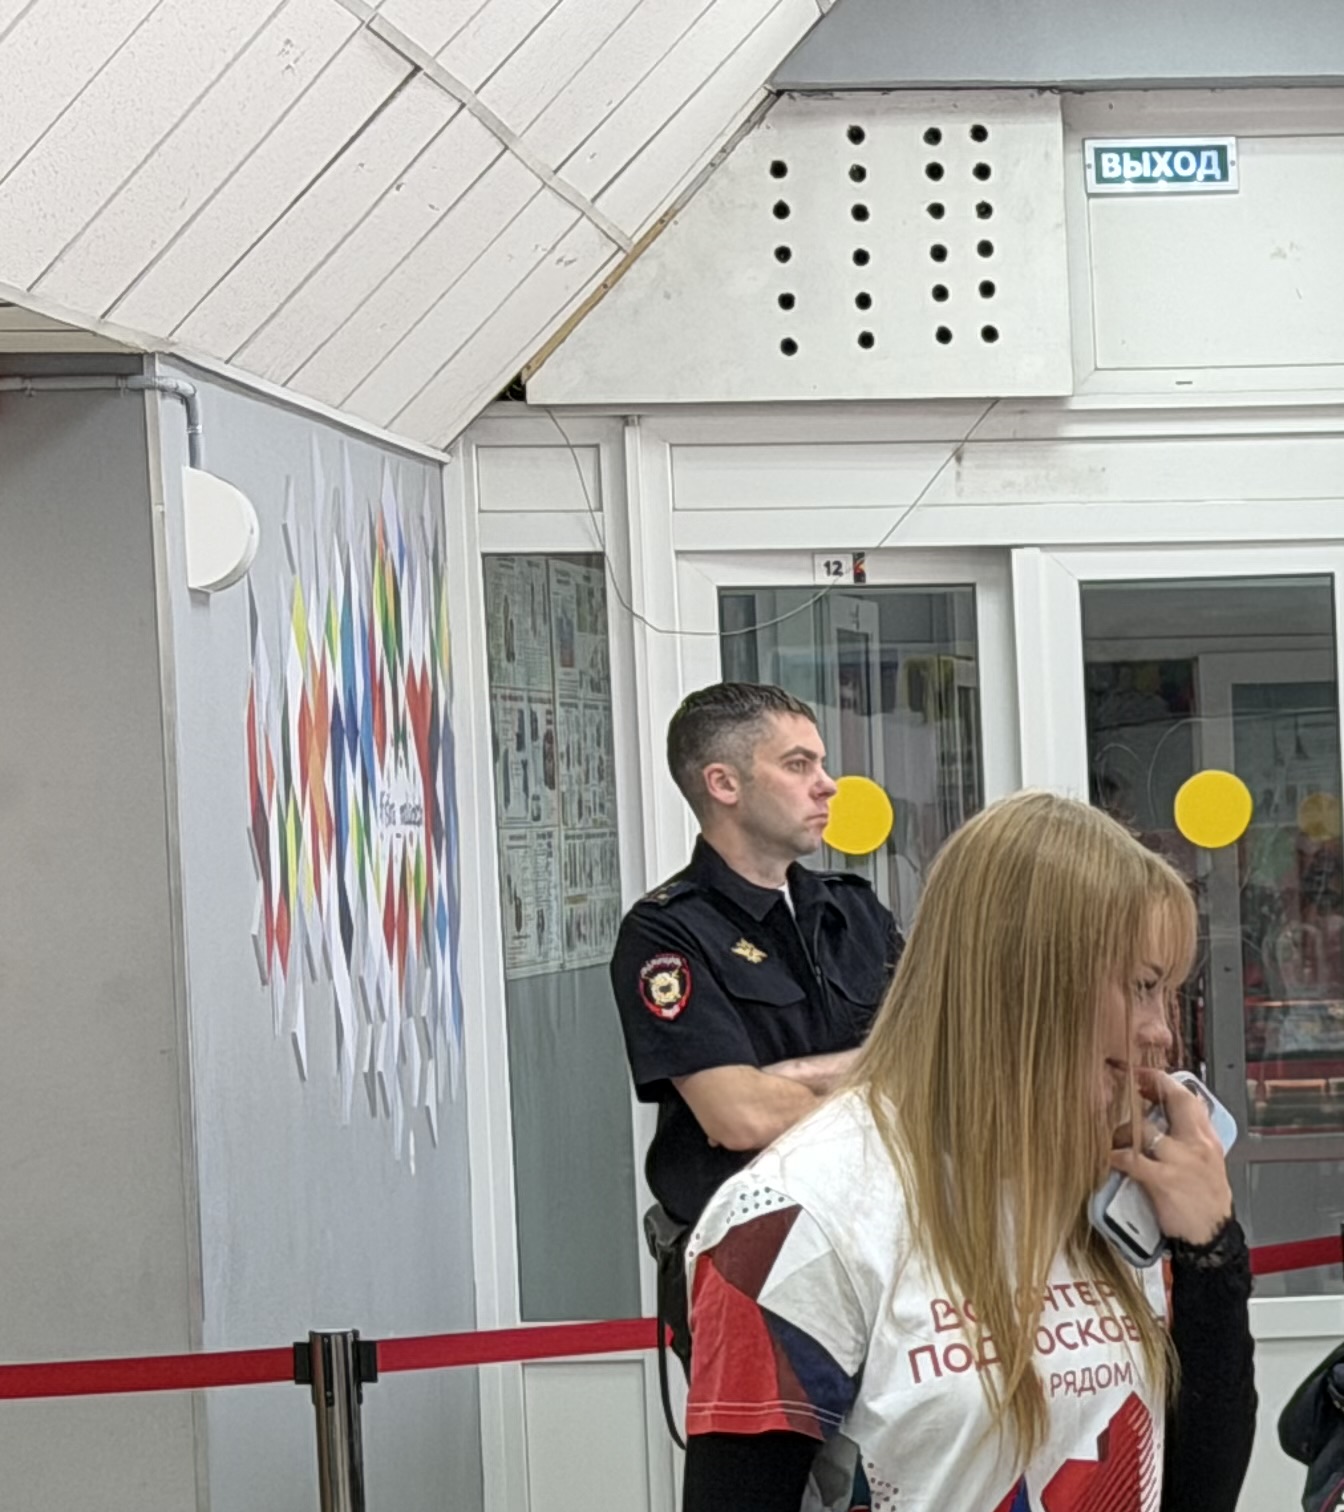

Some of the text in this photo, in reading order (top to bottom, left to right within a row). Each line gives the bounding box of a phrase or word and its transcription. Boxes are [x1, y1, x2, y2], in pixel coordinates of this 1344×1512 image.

[1101, 150, 1222, 182] ВЫХОД
[823, 560, 844, 577] 12
[1050, 1360, 1134, 1398] РЯДОМ
